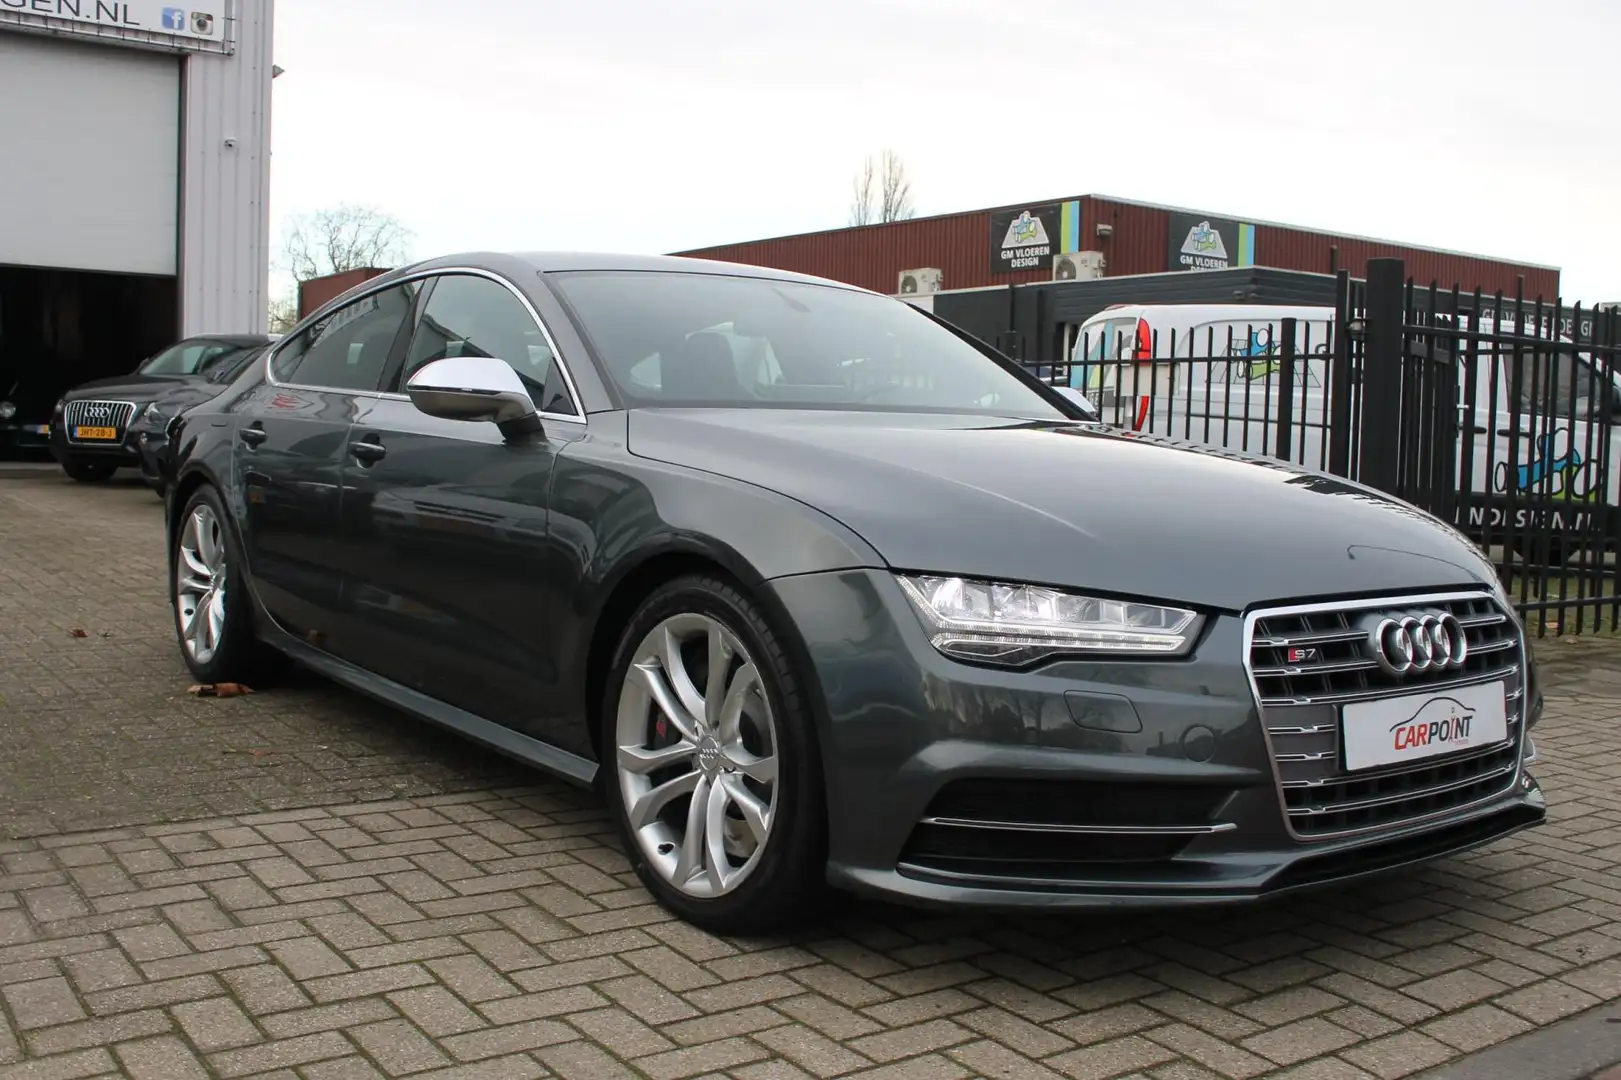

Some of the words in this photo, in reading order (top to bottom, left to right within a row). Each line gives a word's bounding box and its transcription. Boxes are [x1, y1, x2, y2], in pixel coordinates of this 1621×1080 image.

[1001, 250, 1014, 259] GM
[1015, 246, 1050, 258] VLOEREN
[1011, 257, 1039, 268] DESIGN
[1180, 255, 1193, 265] GM
[1195, 257, 1228, 269] VLOEREN
[1294, 648, 1316, 659] S7
[1394, 715, 1473, 750] CARPOINT
